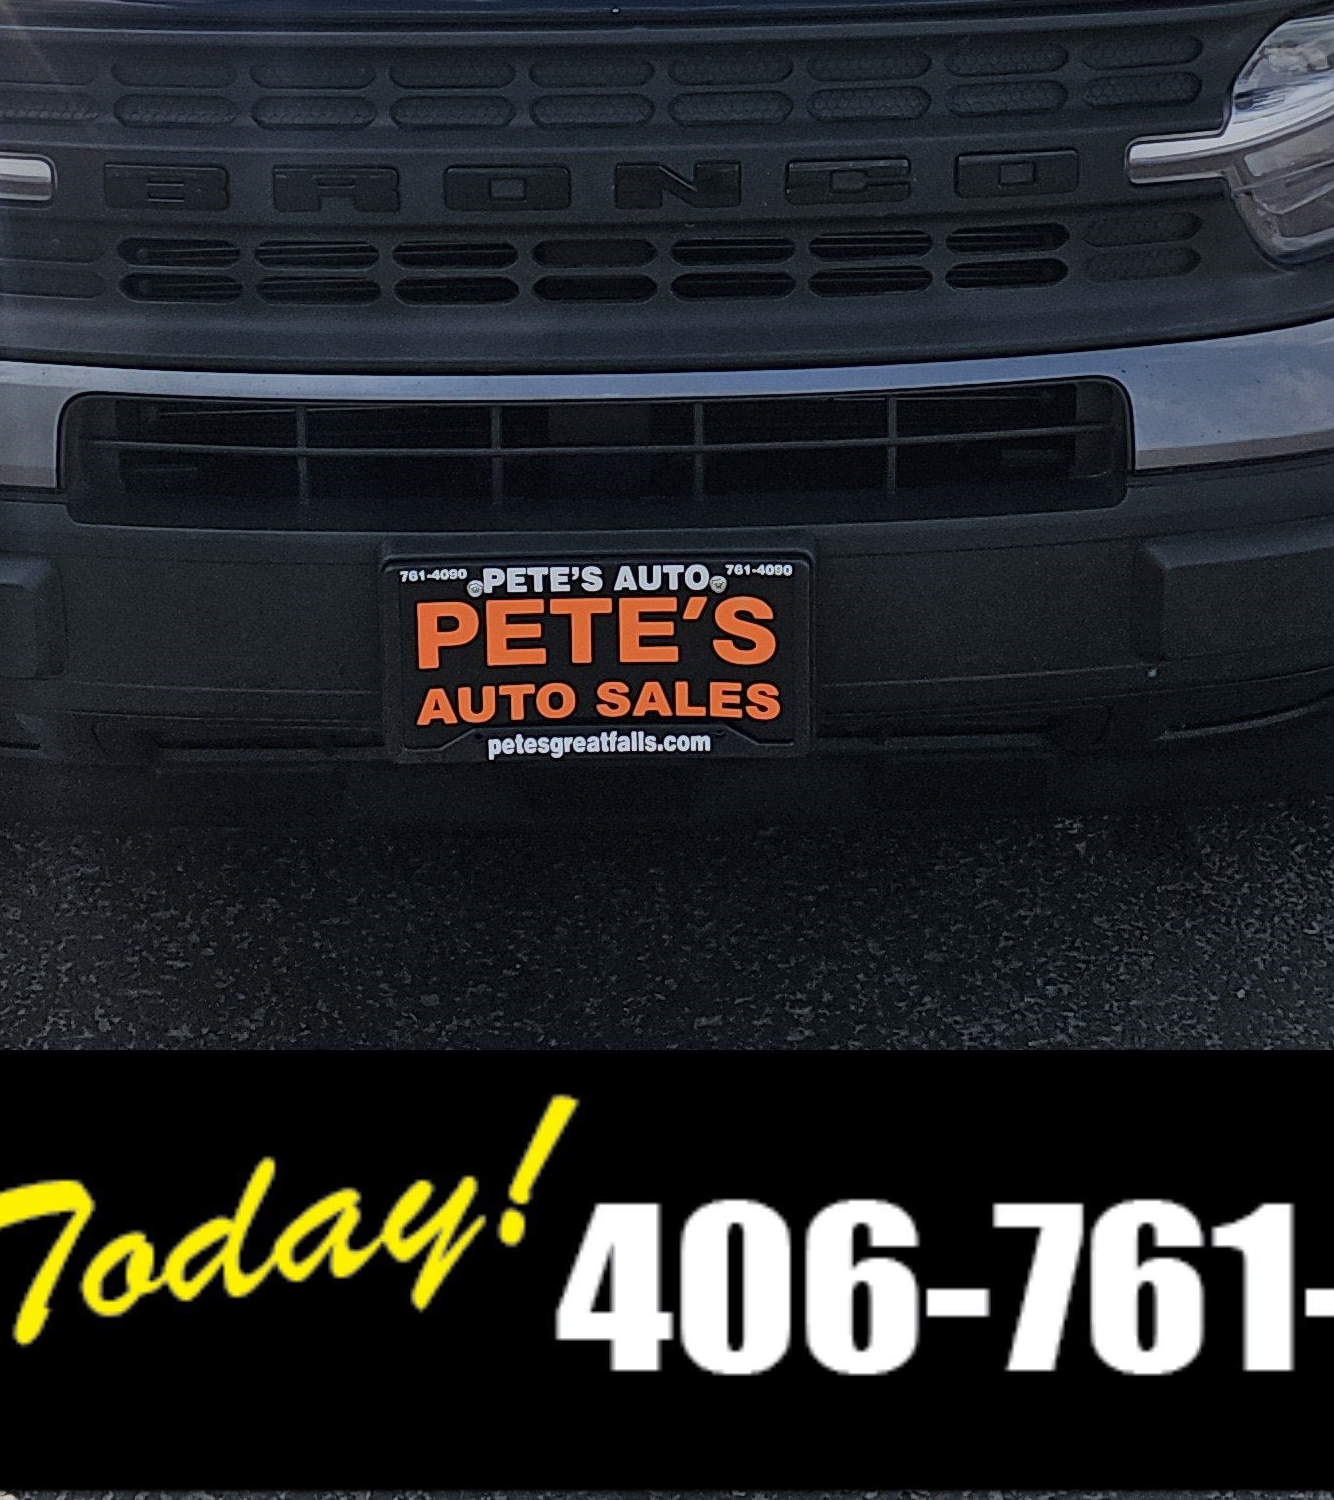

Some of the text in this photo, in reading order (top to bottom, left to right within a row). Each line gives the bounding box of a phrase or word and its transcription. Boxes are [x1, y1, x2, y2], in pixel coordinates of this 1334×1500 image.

[103, 149, 1081, 212] BRONCO
[400, 568, 467, 583] 761-4090
[483, 564, 710, 594] PETE'S AUTO
[725, 563, 793, 577] 761-4090
[417, 596, 777, 670] PETE'S
[417, 681, 781, 726] AUTO SALES
[488, 731, 711, 760] petesgreatfalls.com
